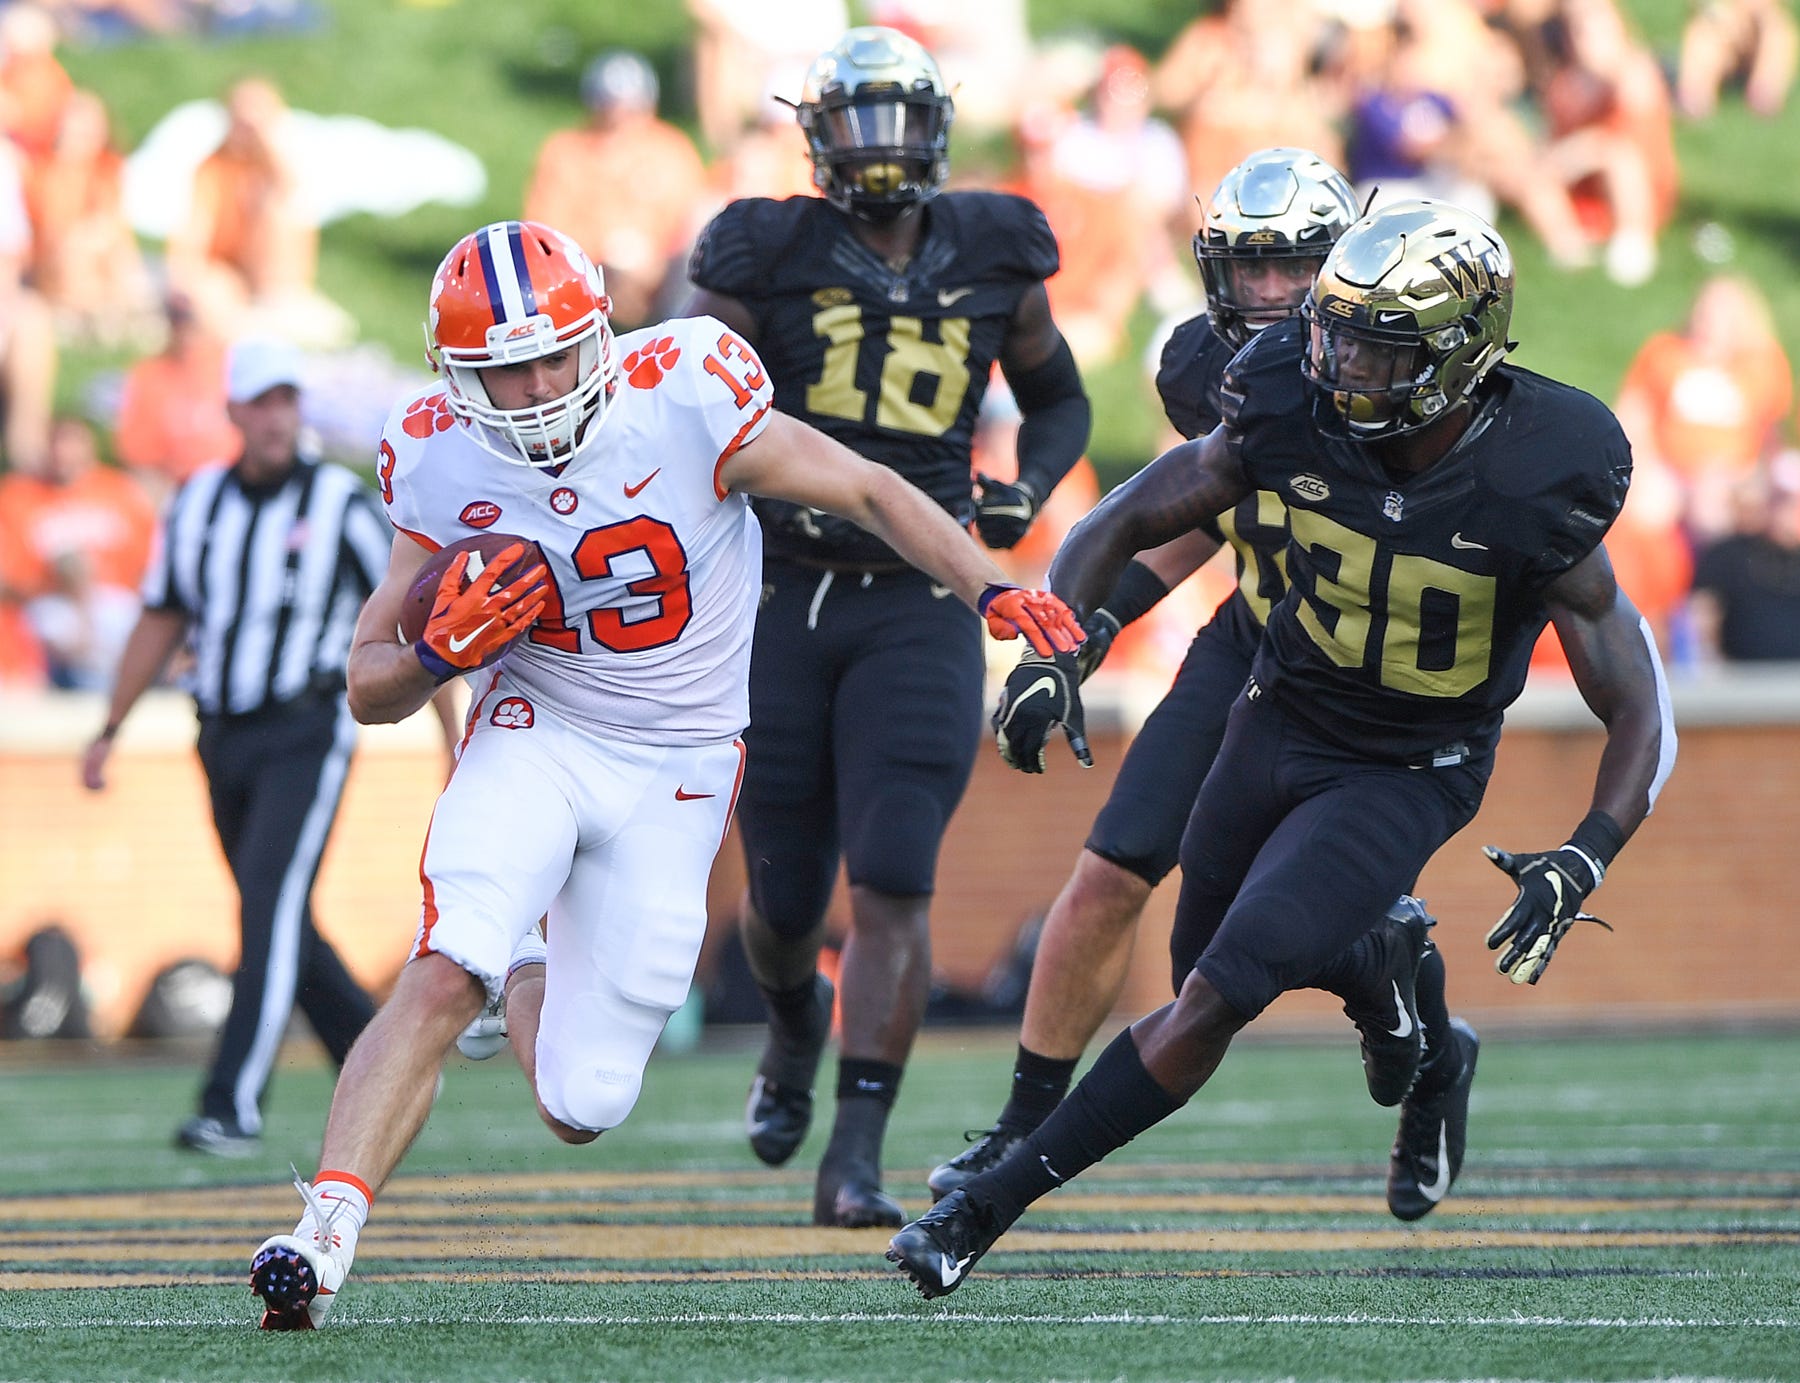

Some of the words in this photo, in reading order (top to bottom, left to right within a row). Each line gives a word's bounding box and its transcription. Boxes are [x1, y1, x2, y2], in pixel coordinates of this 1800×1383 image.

[506, 323, 535, 339] ACC
[1330, 299, 1356, 316] ACC
[703, 332, 765, 410] 13
[806, 304, 971, 437] 18
[1297, 478, 1326, 496] ACC
[466, 505, 496, 520] ACC
[529, 514, 693, 655] 13
[1288, 505, 1496, 698] 30
